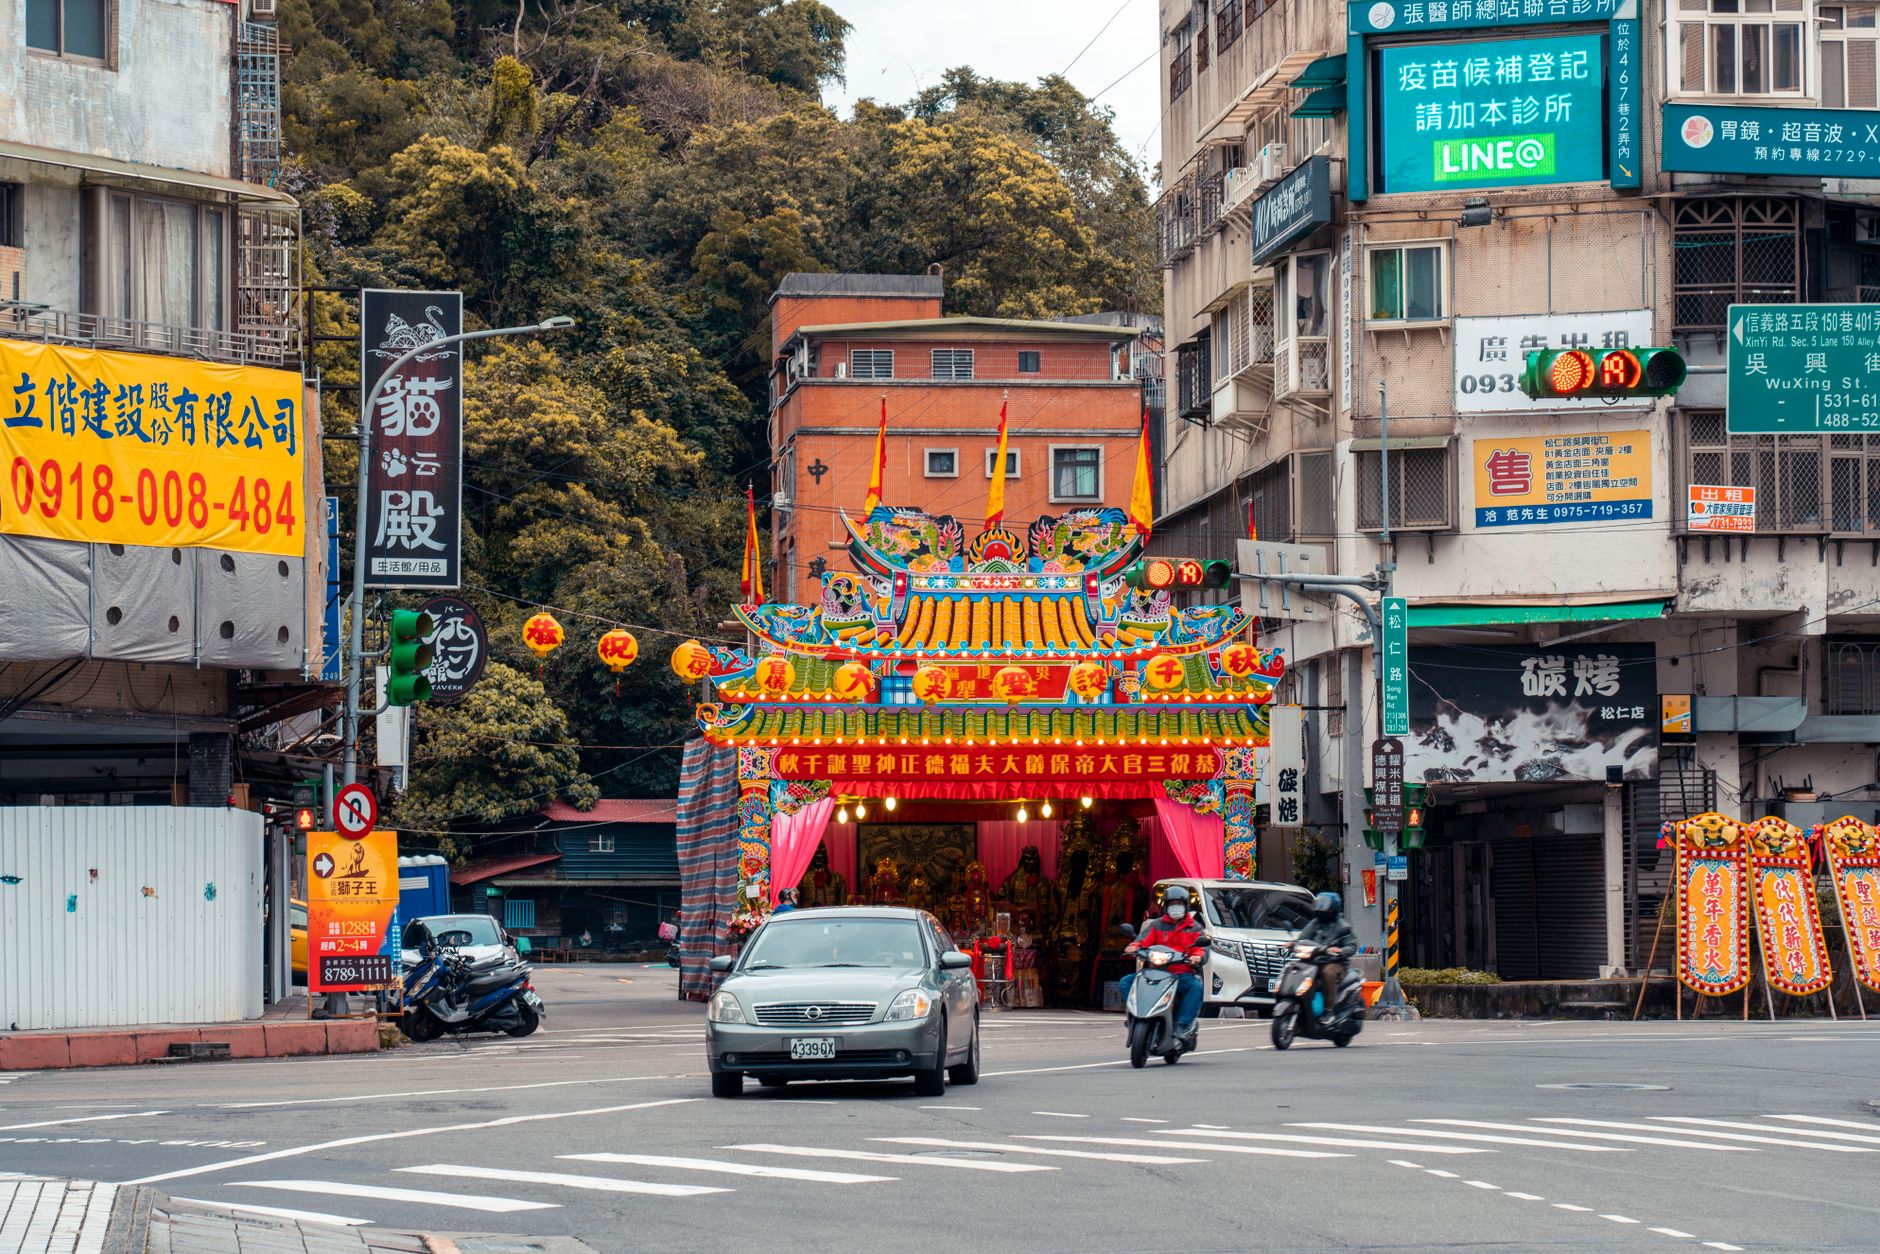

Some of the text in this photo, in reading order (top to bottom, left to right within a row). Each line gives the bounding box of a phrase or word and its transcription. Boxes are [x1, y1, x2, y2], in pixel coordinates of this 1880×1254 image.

[1399, 50, 1588, 91] 疫苗候補登記
[1617, 23, 1631, 159] 位於467巷2弄內
[1415, 93, 1573, 132] 請加本診所
[1443, 139, 1545, 173] LINE@
[1754, 147, 1880, 162] 預約專線2729-
[1745, 336, 1768, 347] XinYi
[1772, 336, 1786, 347] Rd.
[1791, 336, 1809, 347] Sec.
[1811, 336, 1817, 347] 5
[1821, 336, 1838, 347] Lane
[1842, 335, 1855, 346] 150
[1858, 336, 1874, 348] Alley
[1460, 373, 1523, 395] 093
[1766, 377, 1868, 391] WuXing St.
[1824, 393, 1880, 408] 531-61
[4, 372, 297, 457] 立偕建設股份有限公司
[1823, 413, 1880, 427] 488-52
[1486, 449, 1532, 495] 售
[10, 456, 296, 537] 0918-008-484
[1701, 488, 1742, 501] 出租
[1485, 503, 1643, 522] 洽 范先生 0975-719-357
[377, 561, 441, 573] 生活館/用品
[526, 617, 559, 645] 恭
[600, 636, 635, 659] 祝
[1388, 615, 1402, 681] 松仁路
[1155, 659, 1184, 684] 千
[1228, 648, 1260, 677] 秋
[844, 668, 872, 693] 大
[1001, 672, 1029, 696] 聖
[1520, 654, 1621, 697] 碳烤
[1387, 686, 1401, 694] Song
[1600, 706, 1645, 720] 松仁店
[1278, 768, 1298, 822] 碳烤
[338, 881, 378, 895] 獅子王
[341, 920, 369, 935] 1288
[1702, 872, 1724, 972] 萬年香火
[1774, 879, 1808, 974] 代代薪傳
[1855, 880, 1880, 971] 聖誕萬
[325, 967, 387, 981] 8789-1111
